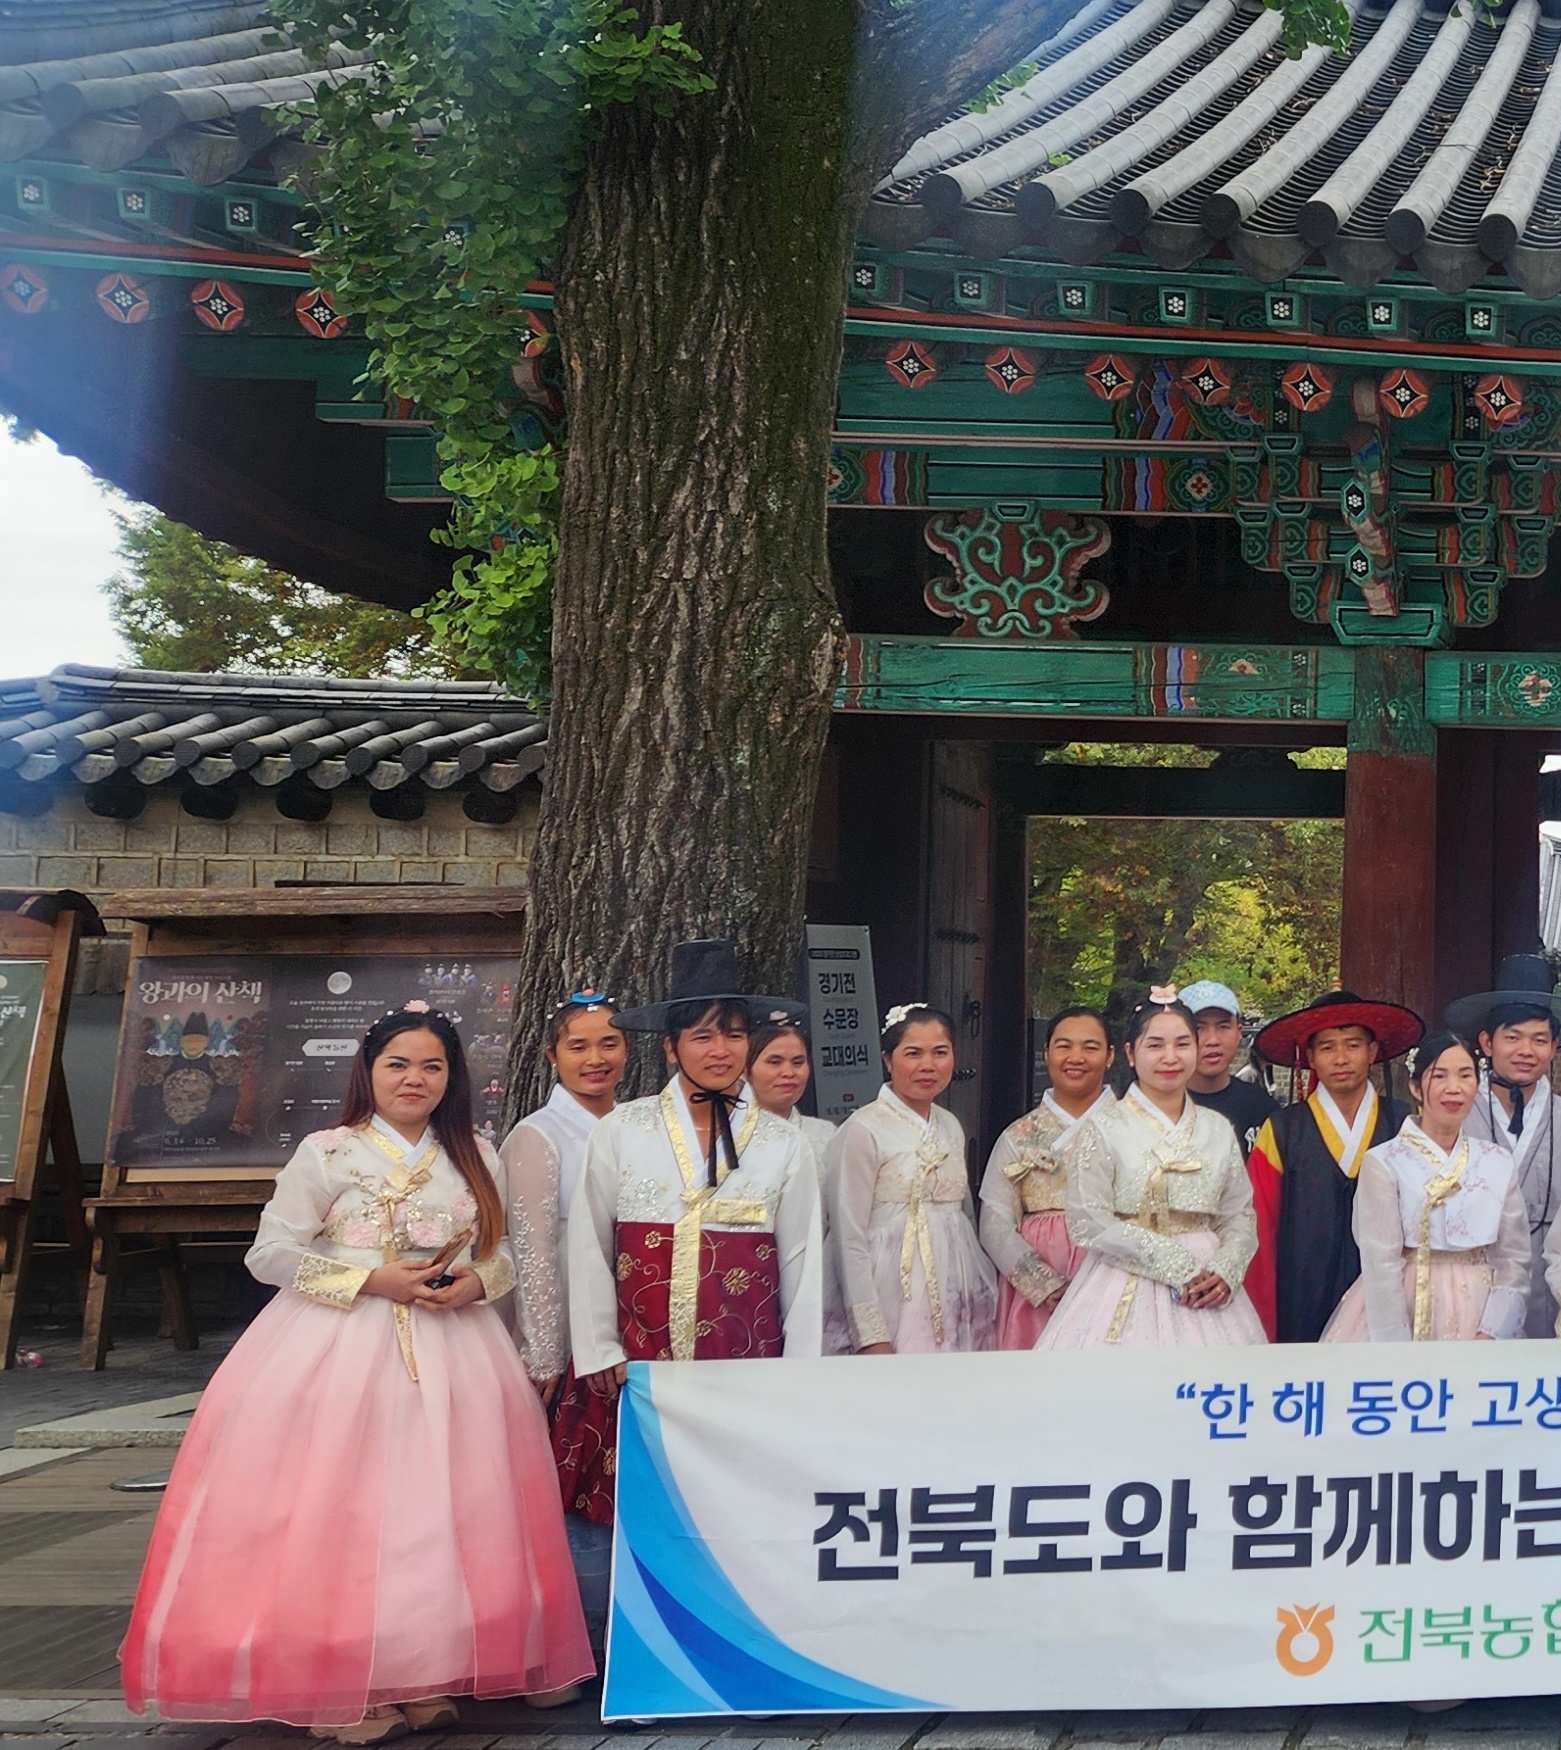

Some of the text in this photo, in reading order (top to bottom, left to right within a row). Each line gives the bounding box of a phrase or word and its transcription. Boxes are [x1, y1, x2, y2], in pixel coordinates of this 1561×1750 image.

[214, 980, 262, 1004] 산책
[818, 972, 856, 995] 경기전
[823, 1008, 859, 1030] 수문장
[821, 1045, 869, 1067] 교대의식
[1272, 1380, 1325, 1437] 해
[1347, 1378, 1454, 1436] 동안
[812, 1478, 1198, 1582] 전북도와
